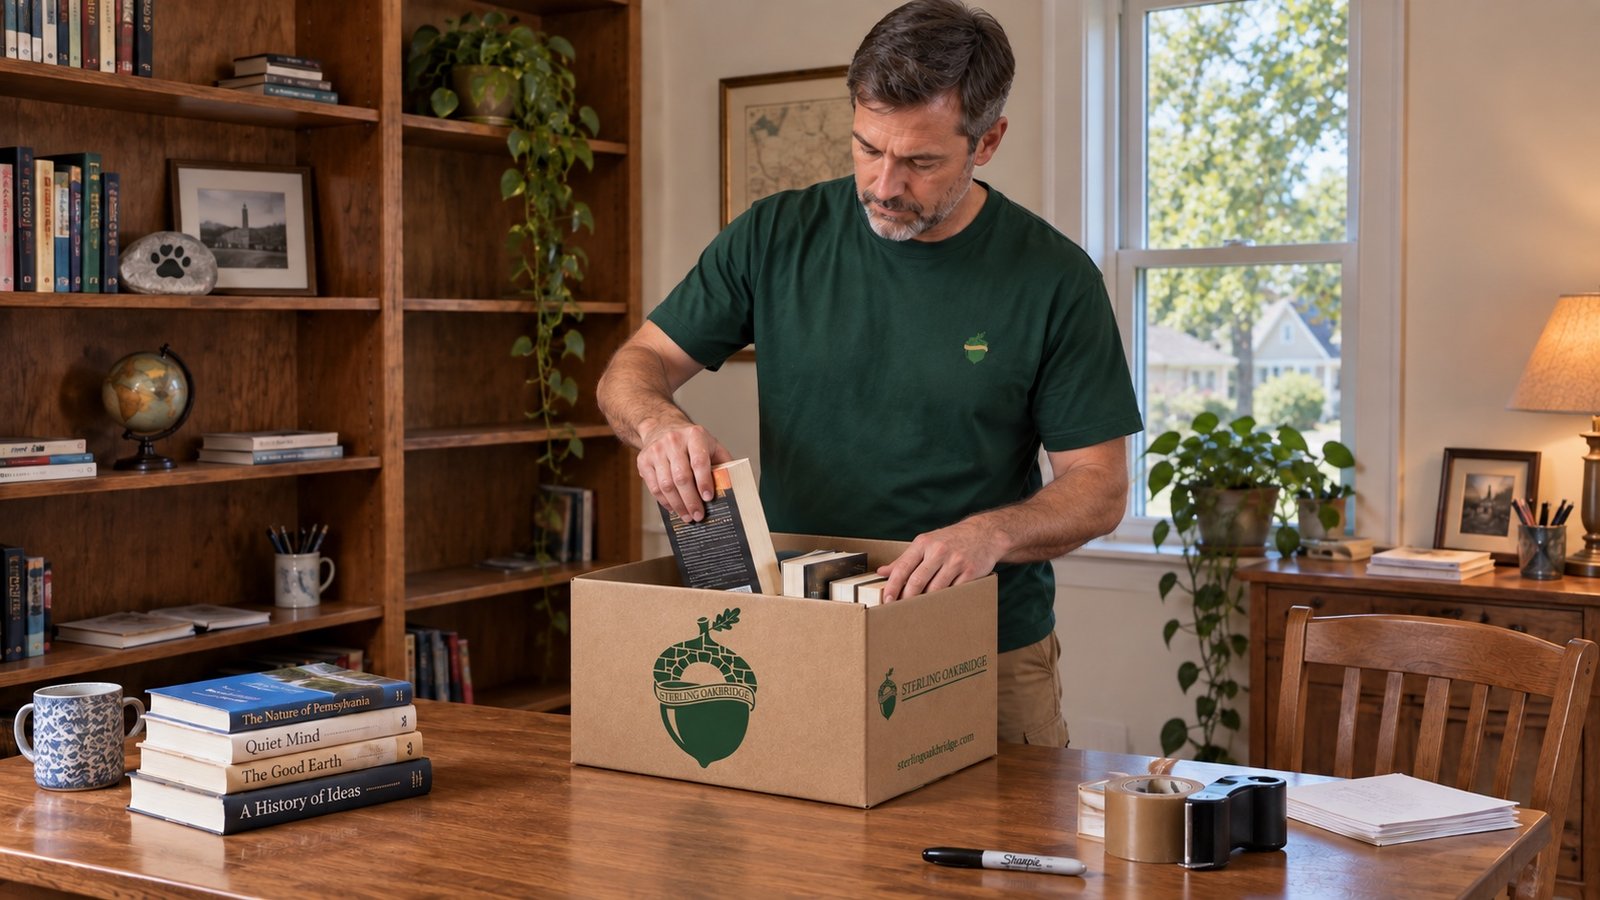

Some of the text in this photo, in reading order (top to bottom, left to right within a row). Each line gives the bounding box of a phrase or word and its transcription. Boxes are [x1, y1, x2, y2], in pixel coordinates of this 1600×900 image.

[902, 655, 988, 696] STERLING OAKBRIDGE
[659, 686, 750, 702] STERLING OAKBRIDGE
[242, 714, 263, 726] The
[265, 709, 299, 722] Nature
[300, 703, 312, 716] of
[245, 728, 321, 755] Quiet Mind
[242, 754, 342, 784] The Good Earth
[240, 786, 361, 820] A History of Ideas
[1000, 854, 1042, 871] Sharpie
